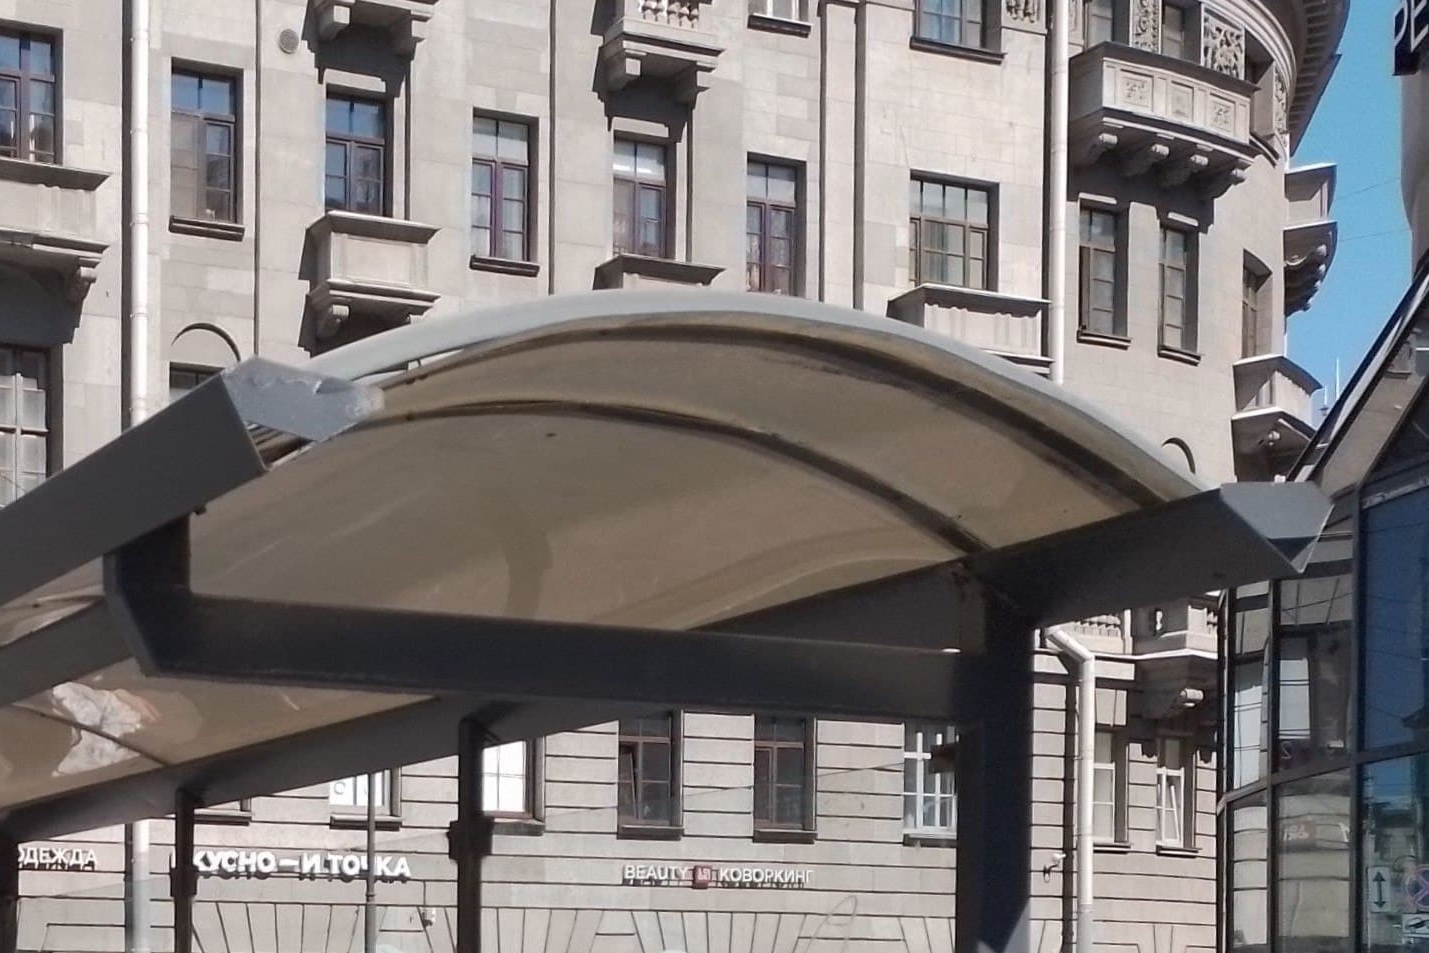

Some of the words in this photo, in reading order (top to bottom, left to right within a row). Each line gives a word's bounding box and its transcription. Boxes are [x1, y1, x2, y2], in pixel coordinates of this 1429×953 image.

[172, 850, 277, 873] КУСНО
[624, 865, 688, 880] BEAUTY
[720, 868, 814, 883] КОВОРКИНГ
